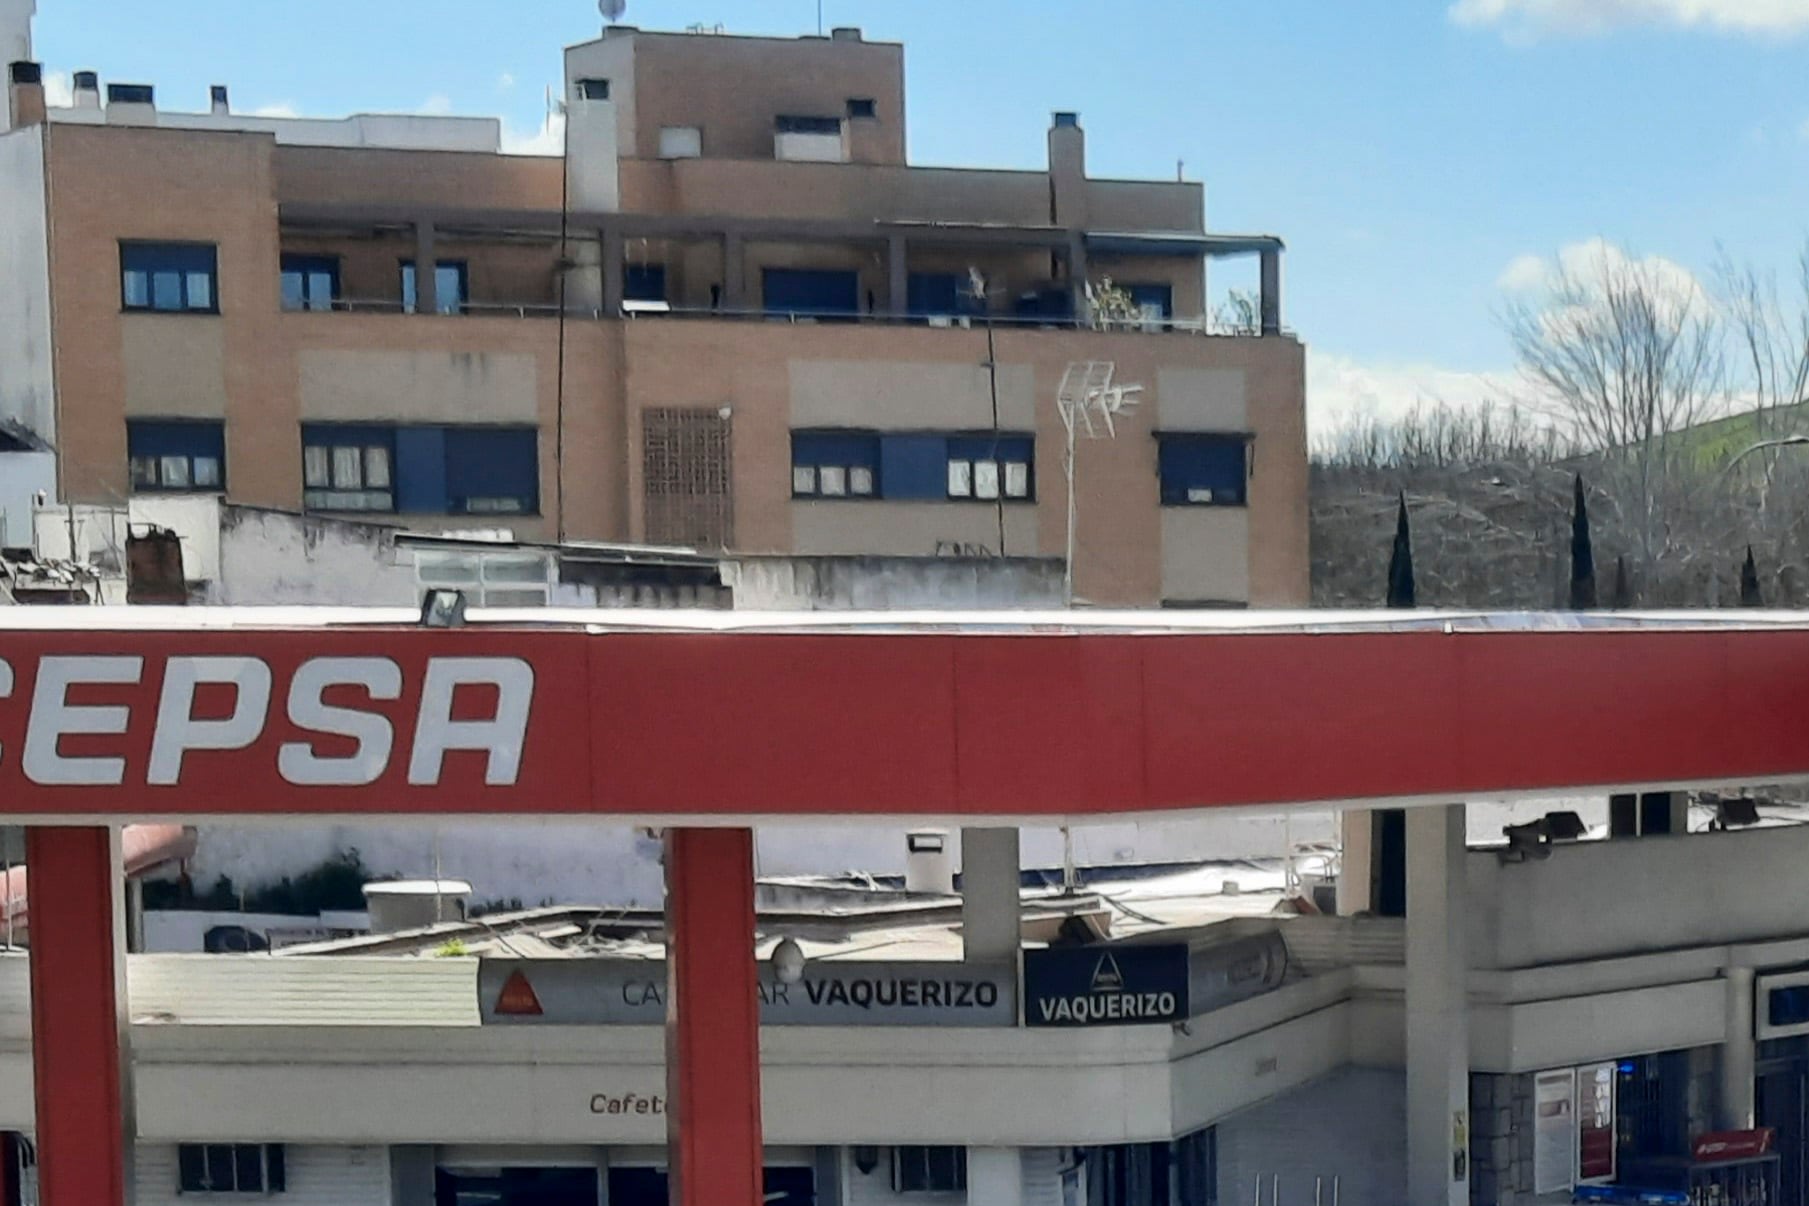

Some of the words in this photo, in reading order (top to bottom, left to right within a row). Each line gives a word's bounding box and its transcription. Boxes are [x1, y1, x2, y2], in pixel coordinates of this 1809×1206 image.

[0, 655, 535, 786] EPSA
[756, 981, 790, 1006] AR
[804, 979, 998, 1009] VAQUERIZO
[1039, 991, 1177, 1023] VAQUERIZO
[590, 1094, 667, 1114] Cafet
